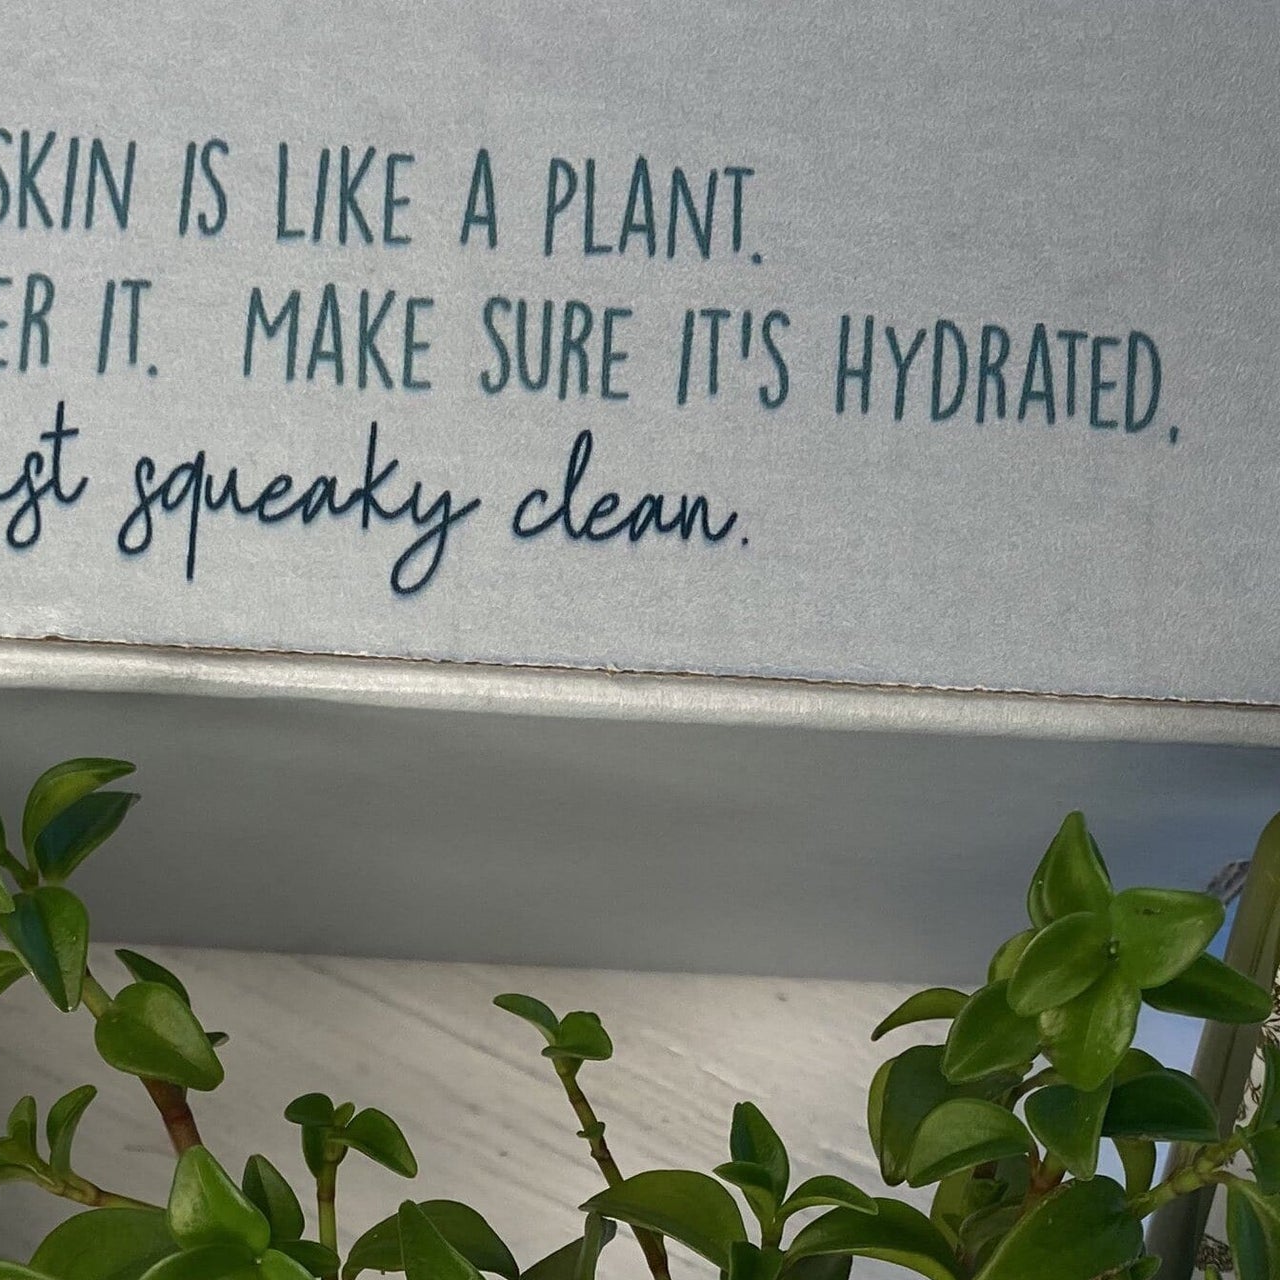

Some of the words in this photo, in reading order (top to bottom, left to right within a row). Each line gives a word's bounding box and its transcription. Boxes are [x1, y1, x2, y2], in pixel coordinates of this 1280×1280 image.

[178, 138, 230, 236] IS
[275, 142, 418, 247] LIKE
[458, 148, 500, 249] A
[542, 156, 766, 265] PLANT.
[97, 278, 160, 377] IT.
[241, 283, 435, 393] MAKE
[478, 295, 635, 401] SURE
[676, 308, 791, 409] IT'S
[118, 421, 482, 598] squeaky
[511, 429, 751, 548] clean.
